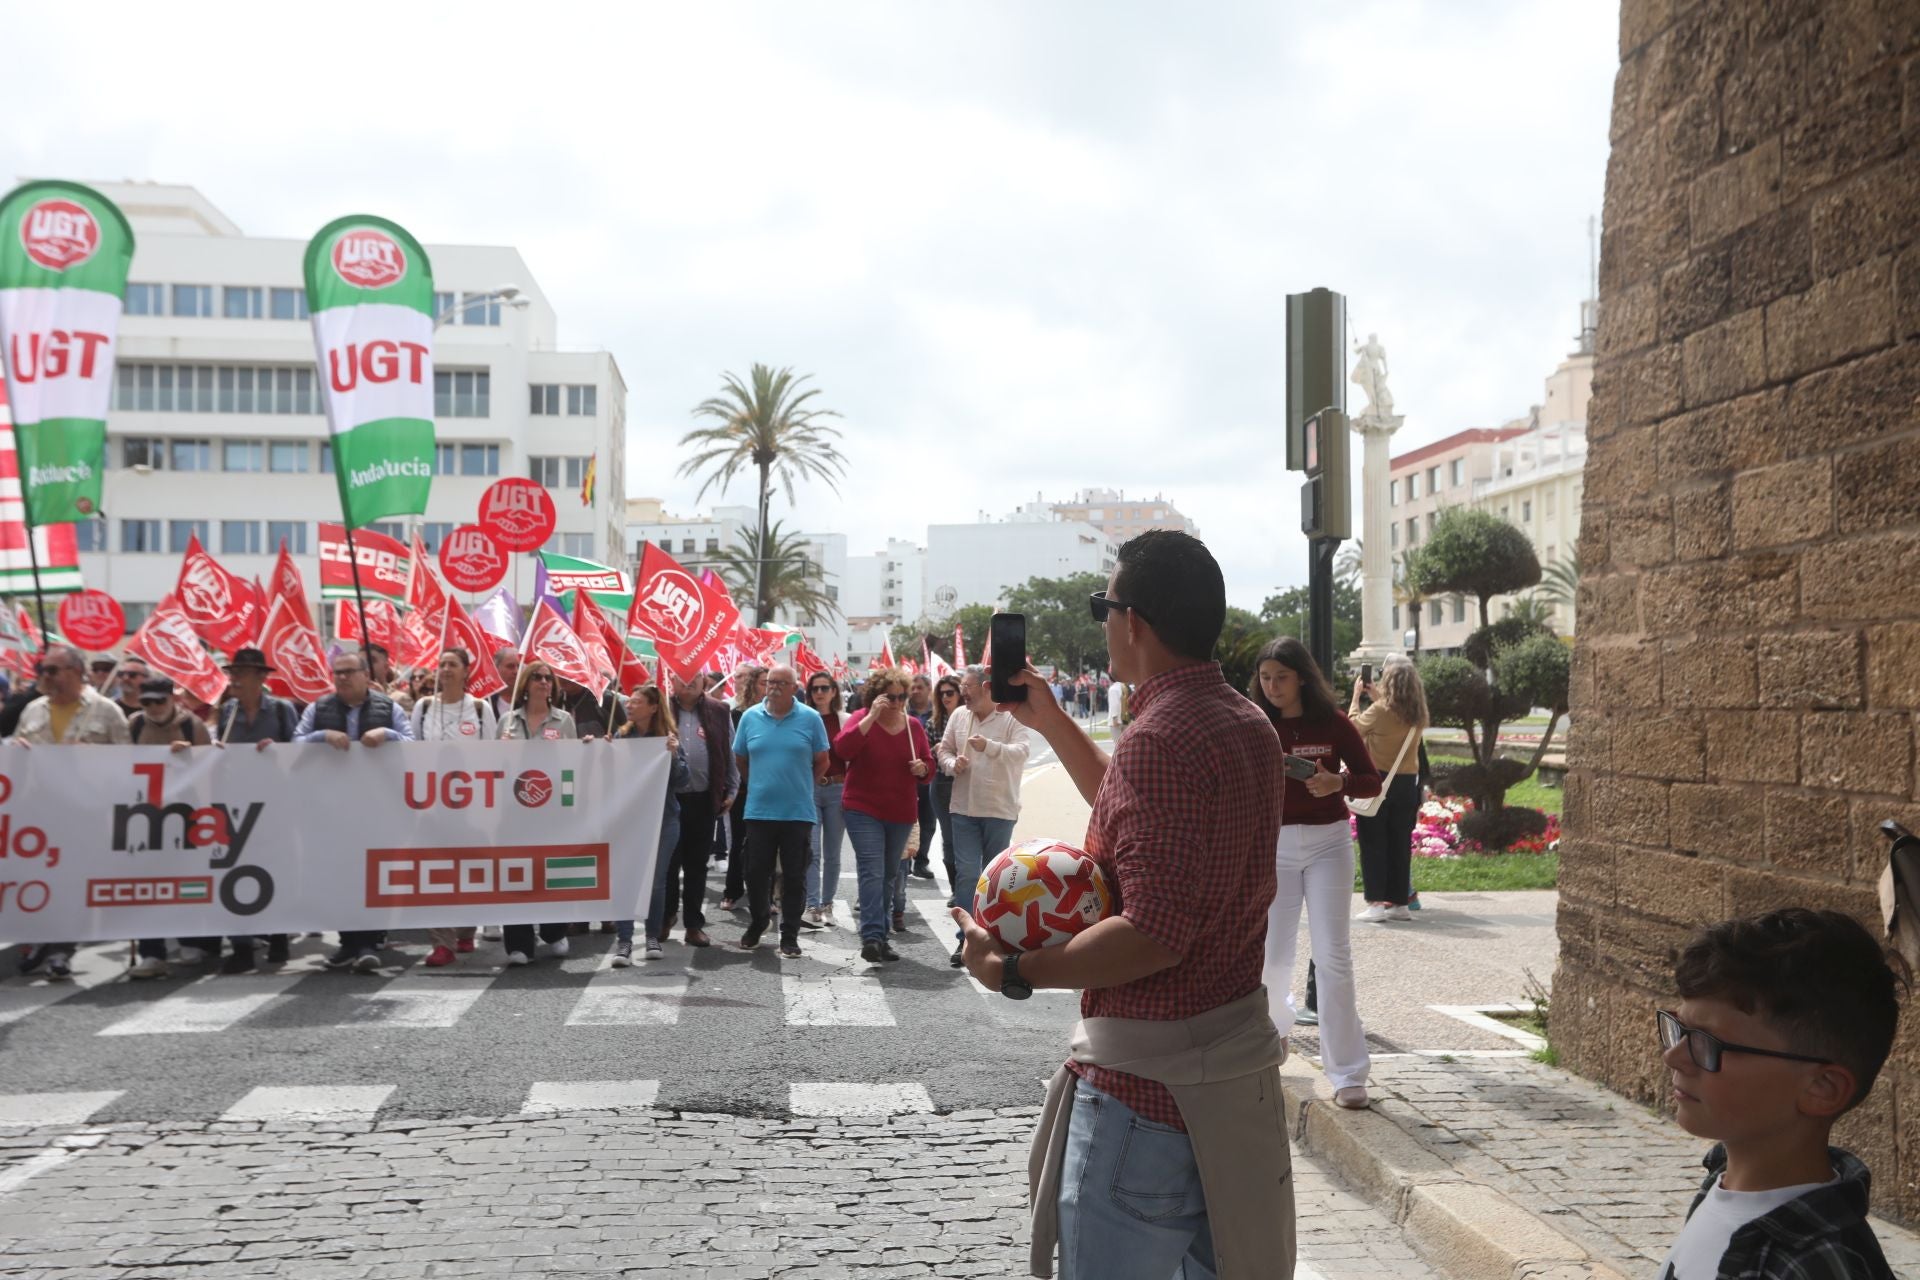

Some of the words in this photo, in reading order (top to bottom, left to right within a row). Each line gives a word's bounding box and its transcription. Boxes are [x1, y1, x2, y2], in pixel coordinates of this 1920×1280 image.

[31, 209, 88, 241] UGT
[342, 237, 396, 263] UGT
[11, 330, 109, 383] UGT
[329, 340, 429, 393] UGT
[489, 485, 544, 514] UGT
[320, 541, 397, 570] CCOO
[448, 532, 497, 558] UGT
[651, 576, 701, 627] UGT
[681, 610, 726, 666] www.ugt.es
[133, 763, 165, 809] 1
[404, 770, 505, 810] UGT
[92, 882, 175, 902] CCOO
[378, 858, 533, 896] CCOO
[1008, 865, 1019, 890] KIPSTA
